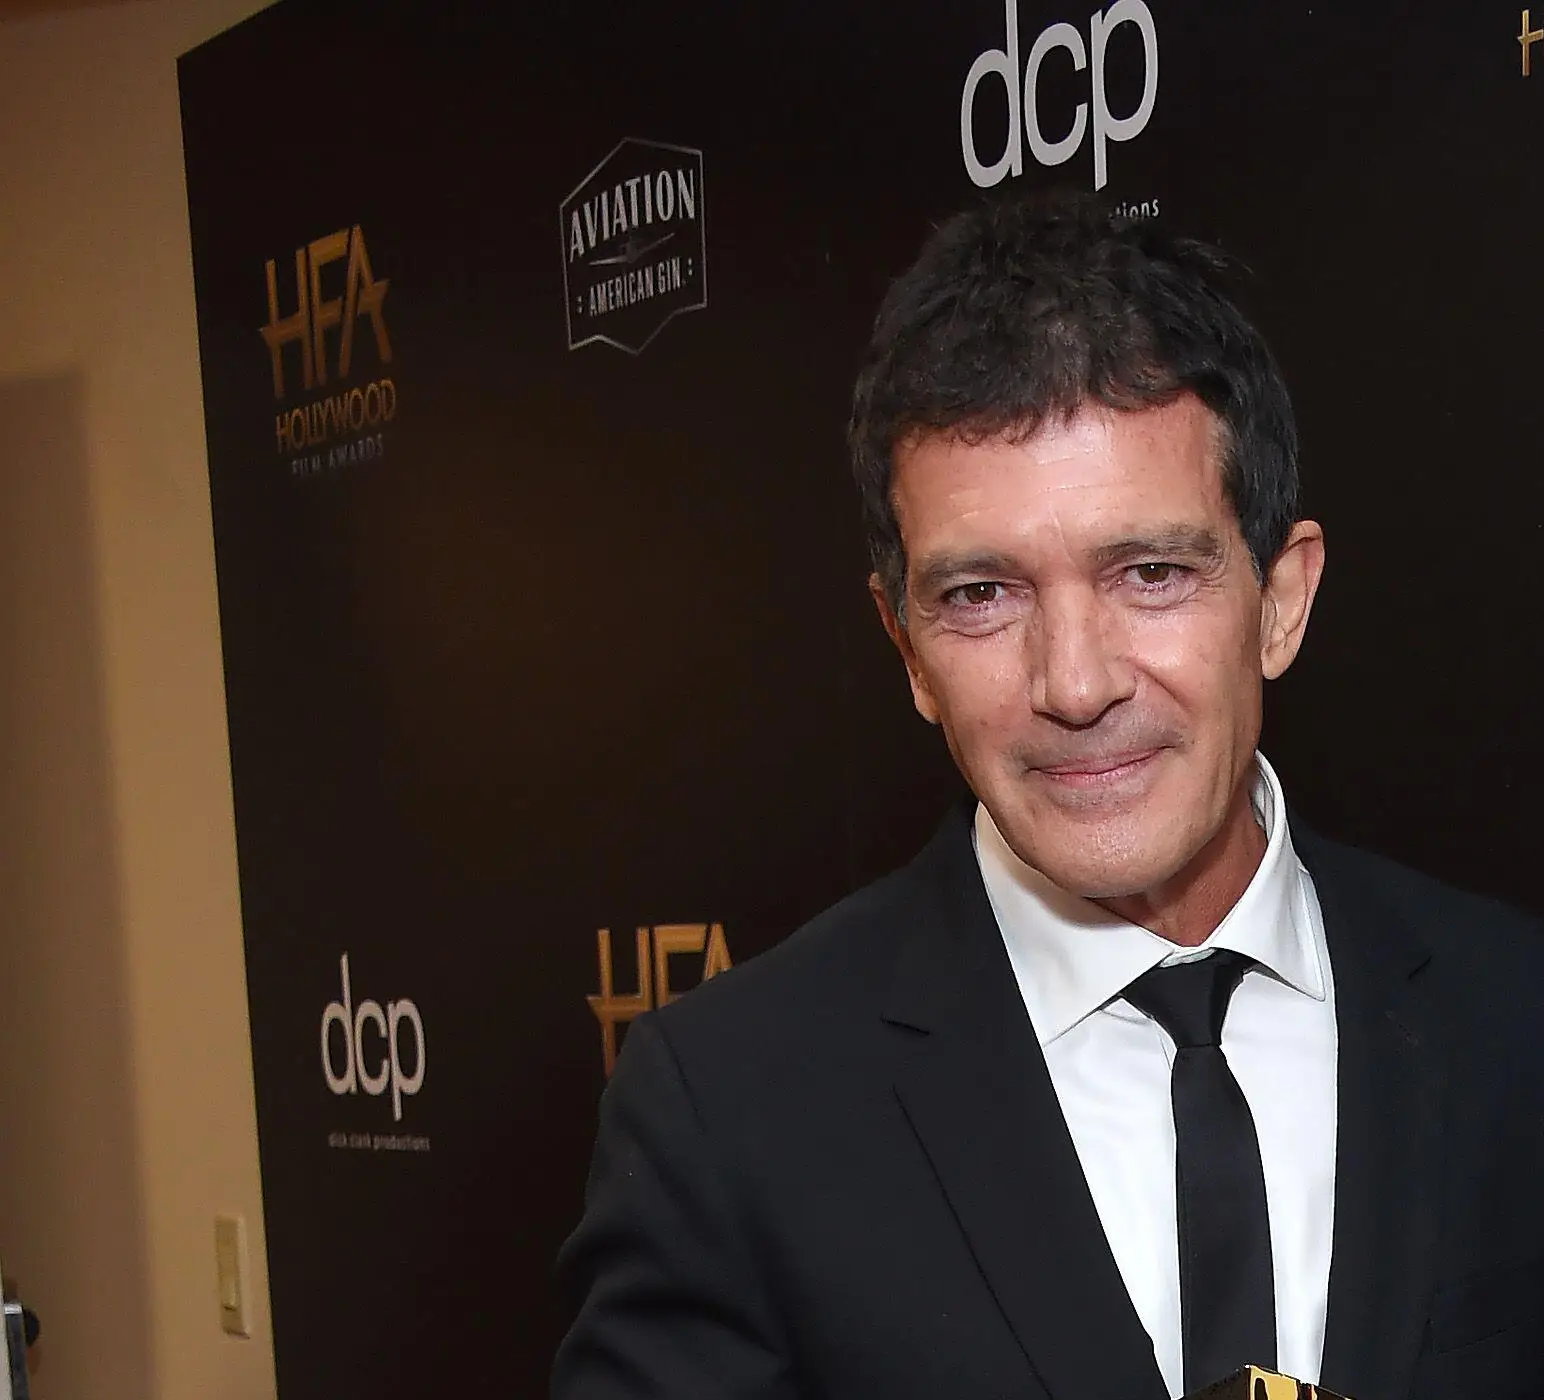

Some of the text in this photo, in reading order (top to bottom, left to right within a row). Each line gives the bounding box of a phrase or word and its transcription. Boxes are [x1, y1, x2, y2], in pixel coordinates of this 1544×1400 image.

[961, 0, 1159, 192] dcp
[569, 168, 695, 263] AVIATION
[257, 223, 392, 399] HFA
[589, 265, 654, 317] AMERICAN
[275, 378, 397, 453] HOLLYWOOD
[320, 950, 427, 1122] dcp
